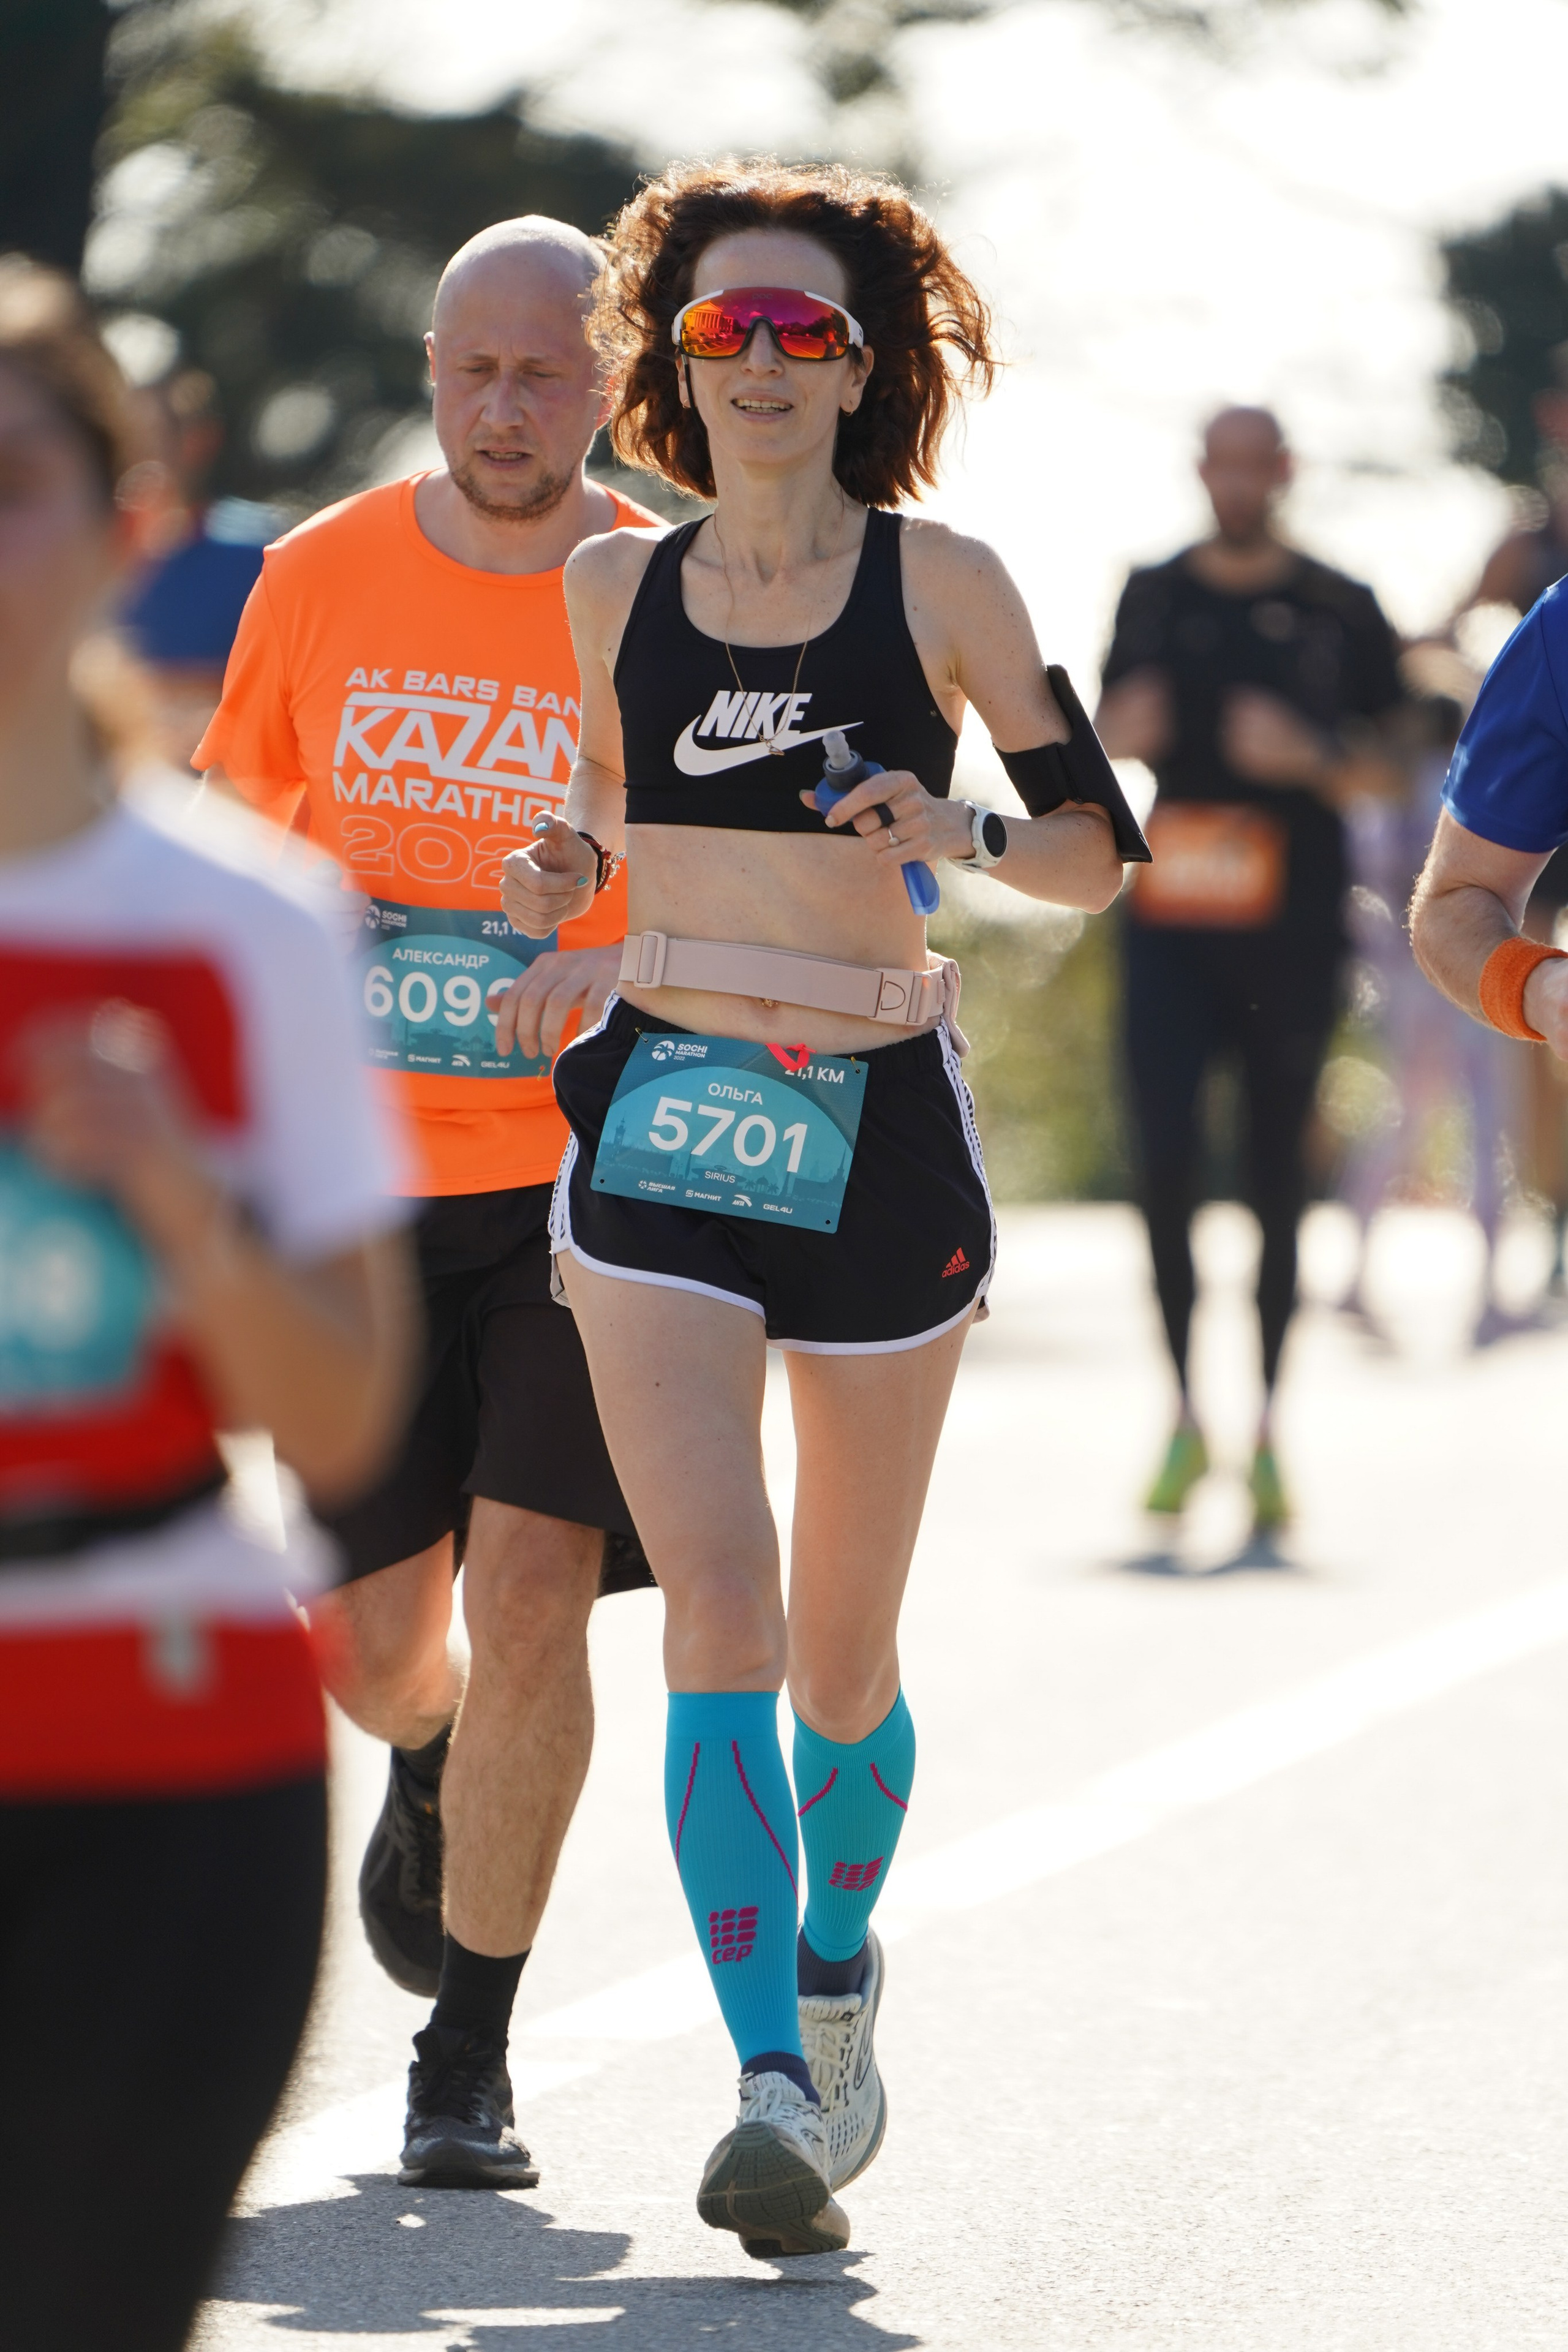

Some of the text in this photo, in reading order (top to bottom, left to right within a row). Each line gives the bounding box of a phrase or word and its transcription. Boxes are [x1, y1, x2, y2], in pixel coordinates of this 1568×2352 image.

[345, 667, 392, 688] AK
[402, 670, 500, 701] BARS
[696, 690, 813, 739] NIKE
[333, 692, 579, 798] KAZAN
[332, 771, 565, 827] MARATHO
[382, 910, 407, 923] SOCHI
[481, 920, 508, 937] 21,1
[392, 948, 489, 970] АЛЕКСАНДР
[675, 1050, 706, 1058] MARATHON
[677, 1043, 708, 1054] SOCHI
[708, 1083, 763, 1105] ОЛЬГА
[648, 1096, 808, 1174] 5701
[704, 1171, 736, 1183] SIRIUS
[649, 1182, 676, 1191] ВЫСШАЯ
[694, 1192, 722, 1202] МАГНИТ
[763, 1204, 793, 1214] GEL4U
[941, 1261, 970, 1278] adidas
[712, 1943, 753, 1965] cep
